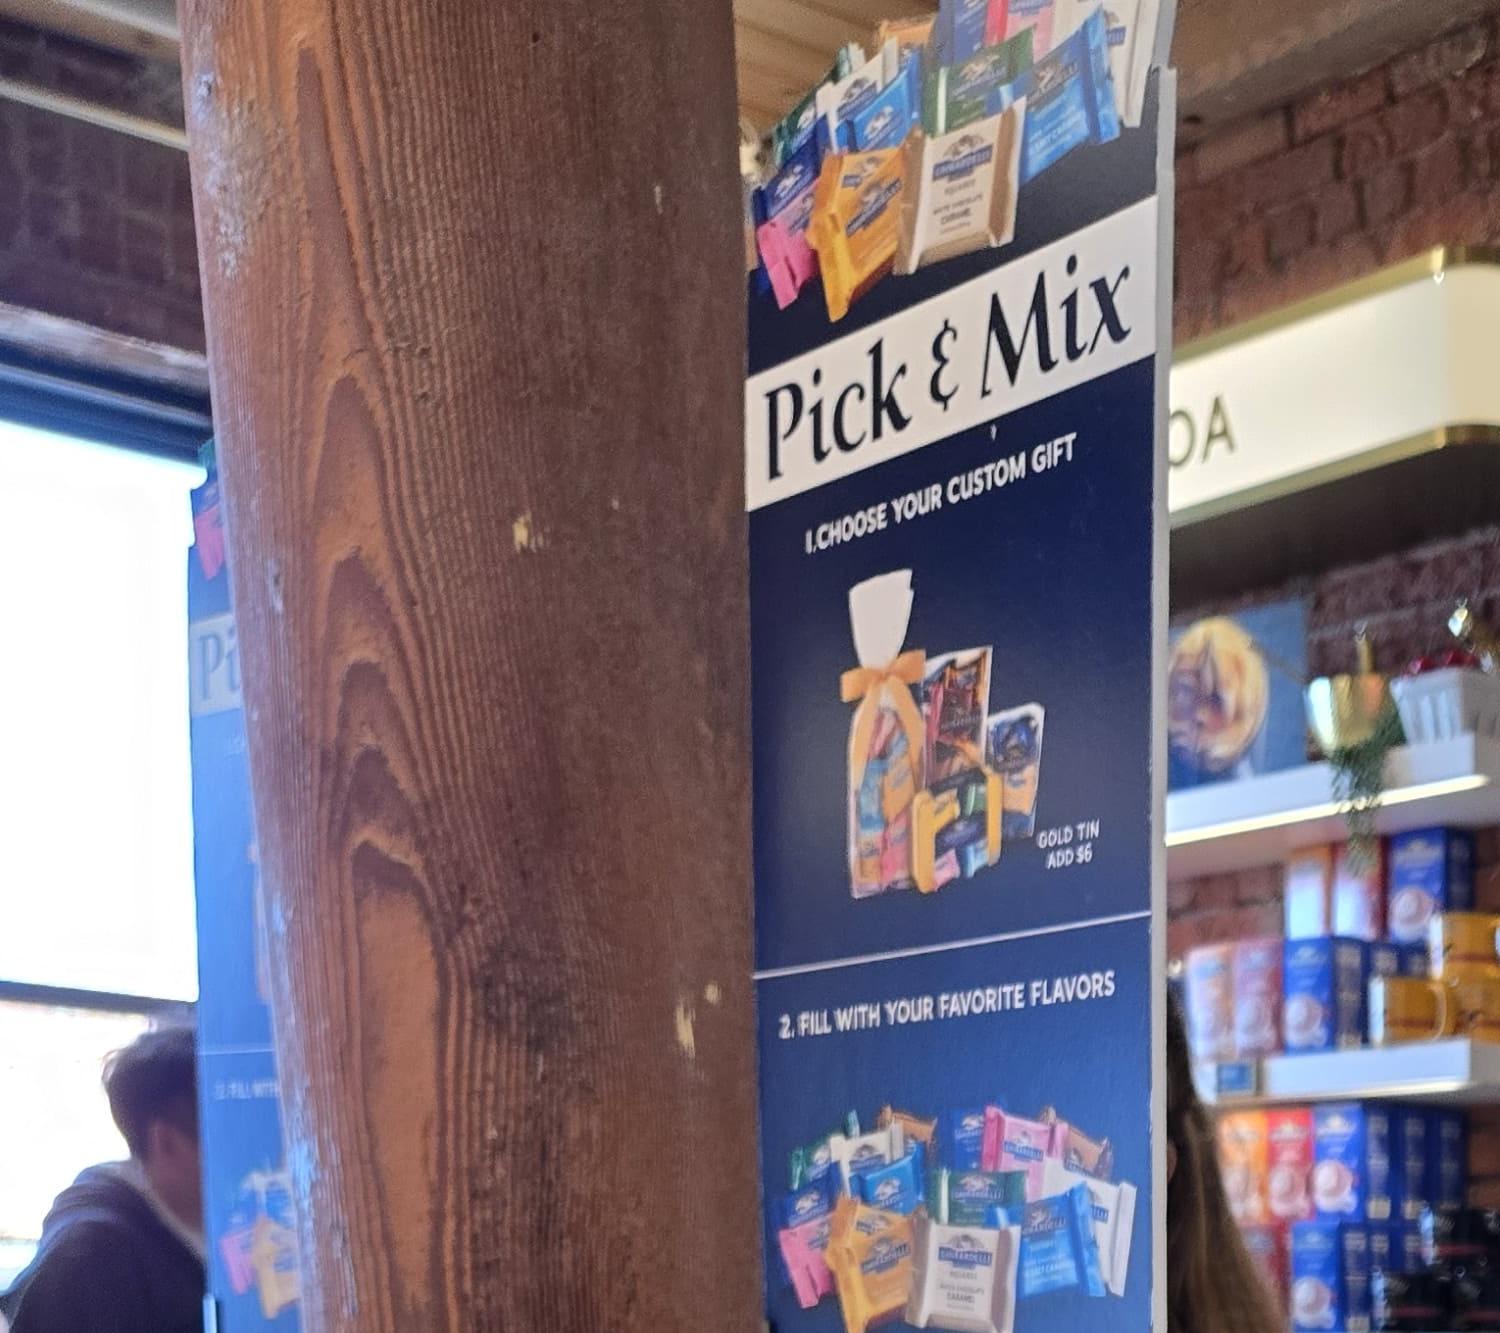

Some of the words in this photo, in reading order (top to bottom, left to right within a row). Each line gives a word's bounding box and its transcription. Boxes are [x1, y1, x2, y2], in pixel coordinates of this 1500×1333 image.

[765, 338, 912, 482] Pick
[929, 320, 959, 410] &
[980, 254, 1131, 398] Mix
[891, 483, 942, 524] YOUR
[946, 451, 1027, 505] CUSTOM
[1031, 433, 1077, 474] GIFT
[1038, 825, 1074, 850] GOLD
[1077, 818, 1100, 841] TIN
[1046, 848, 1074, 870] ADD
[1075, 845, 1093, 866] $6
[779, 1016, 795, 1039] 2.
[799, 1010, 832, 1037] FILL
[834, 1002, 880, 1032] WITH
[884, 996, 934, 1025] YOUR
[939, 984, 1025, 1019] FAVORITE
[1030, 970, 1115, 1007] FLAVORS
